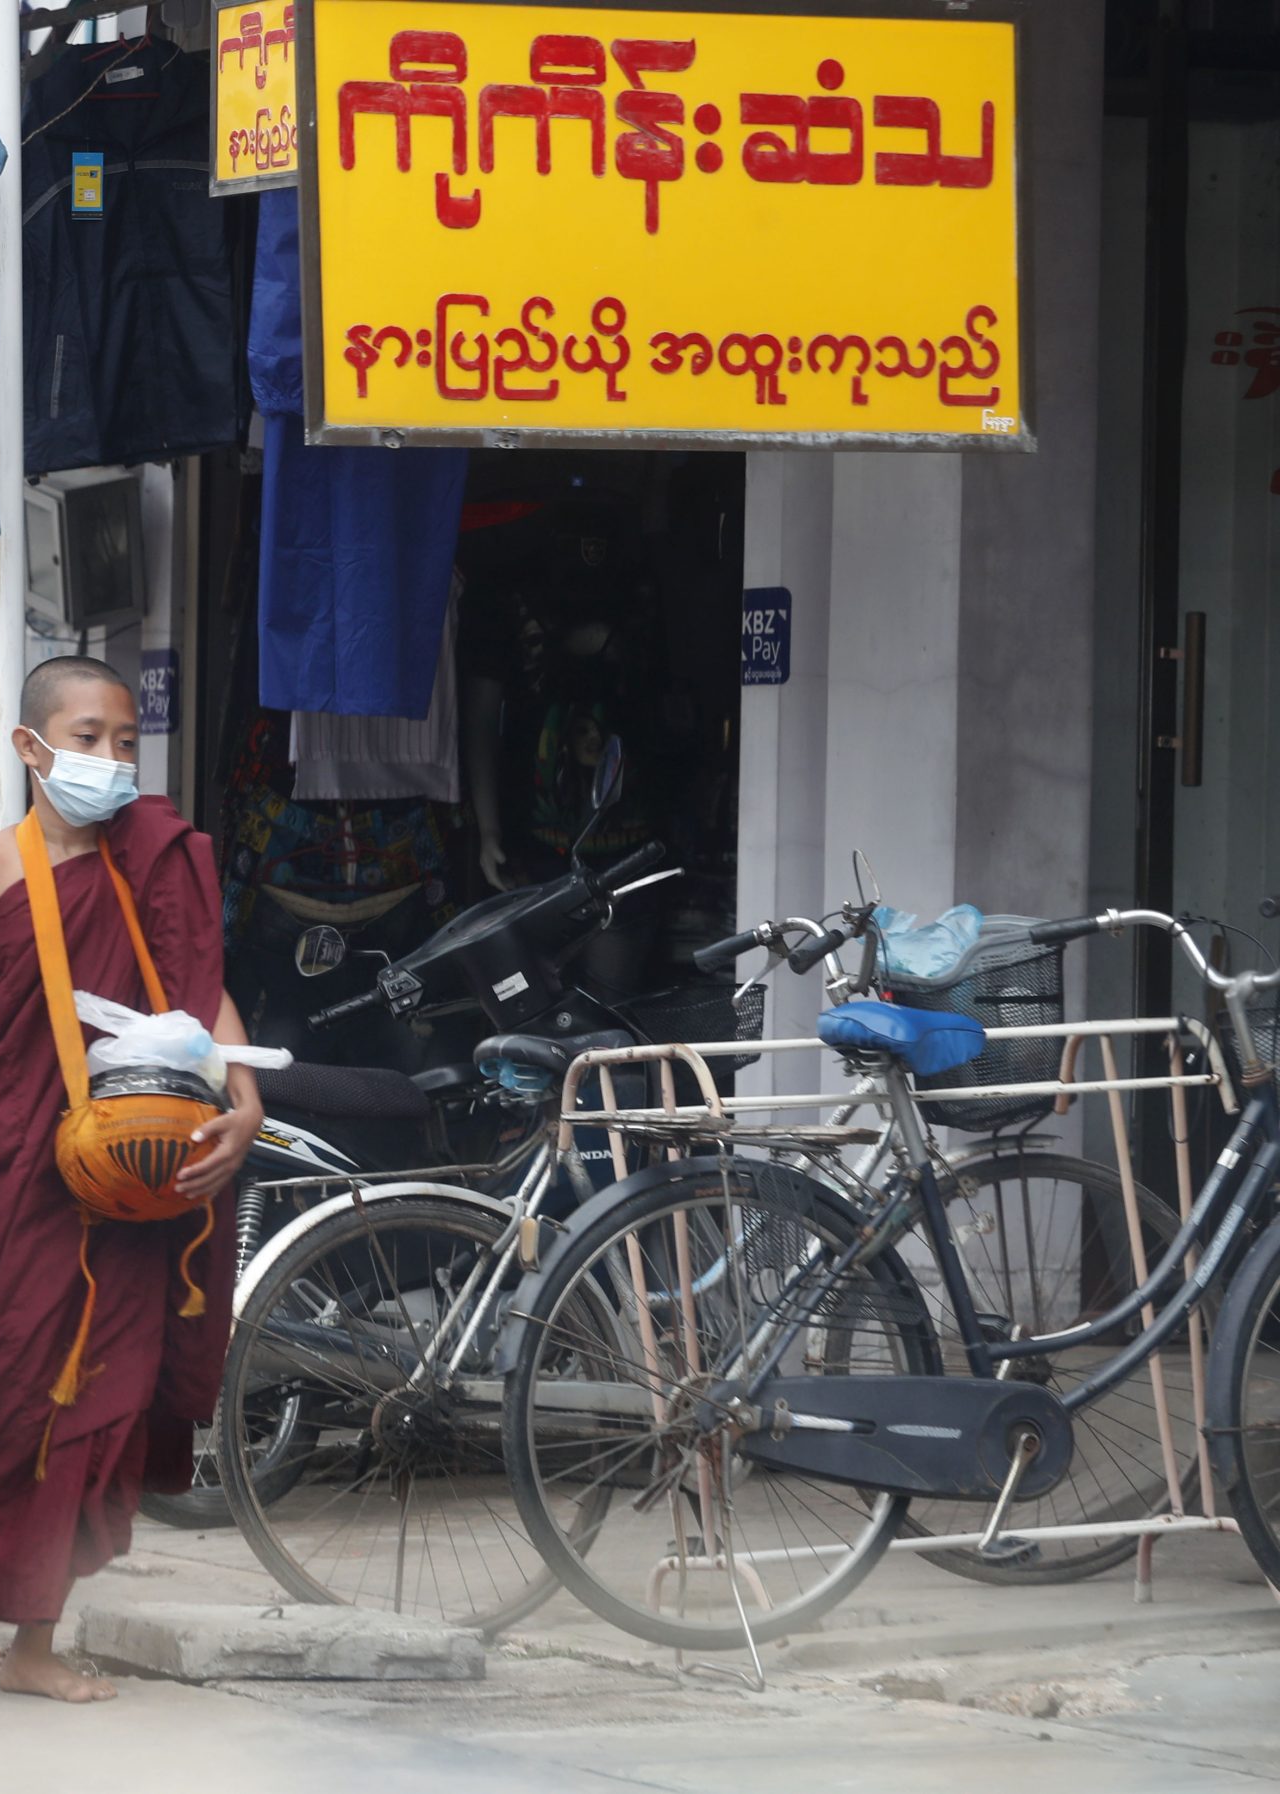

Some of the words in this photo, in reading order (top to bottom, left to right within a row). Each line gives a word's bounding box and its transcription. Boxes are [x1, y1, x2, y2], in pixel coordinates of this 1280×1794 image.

[742, 609, 775, 635] KBZ
[752, 636, 781, 665] Pay
[140, 667, 166, 691] KBZ
[147, 691, 171, 717] Pay
